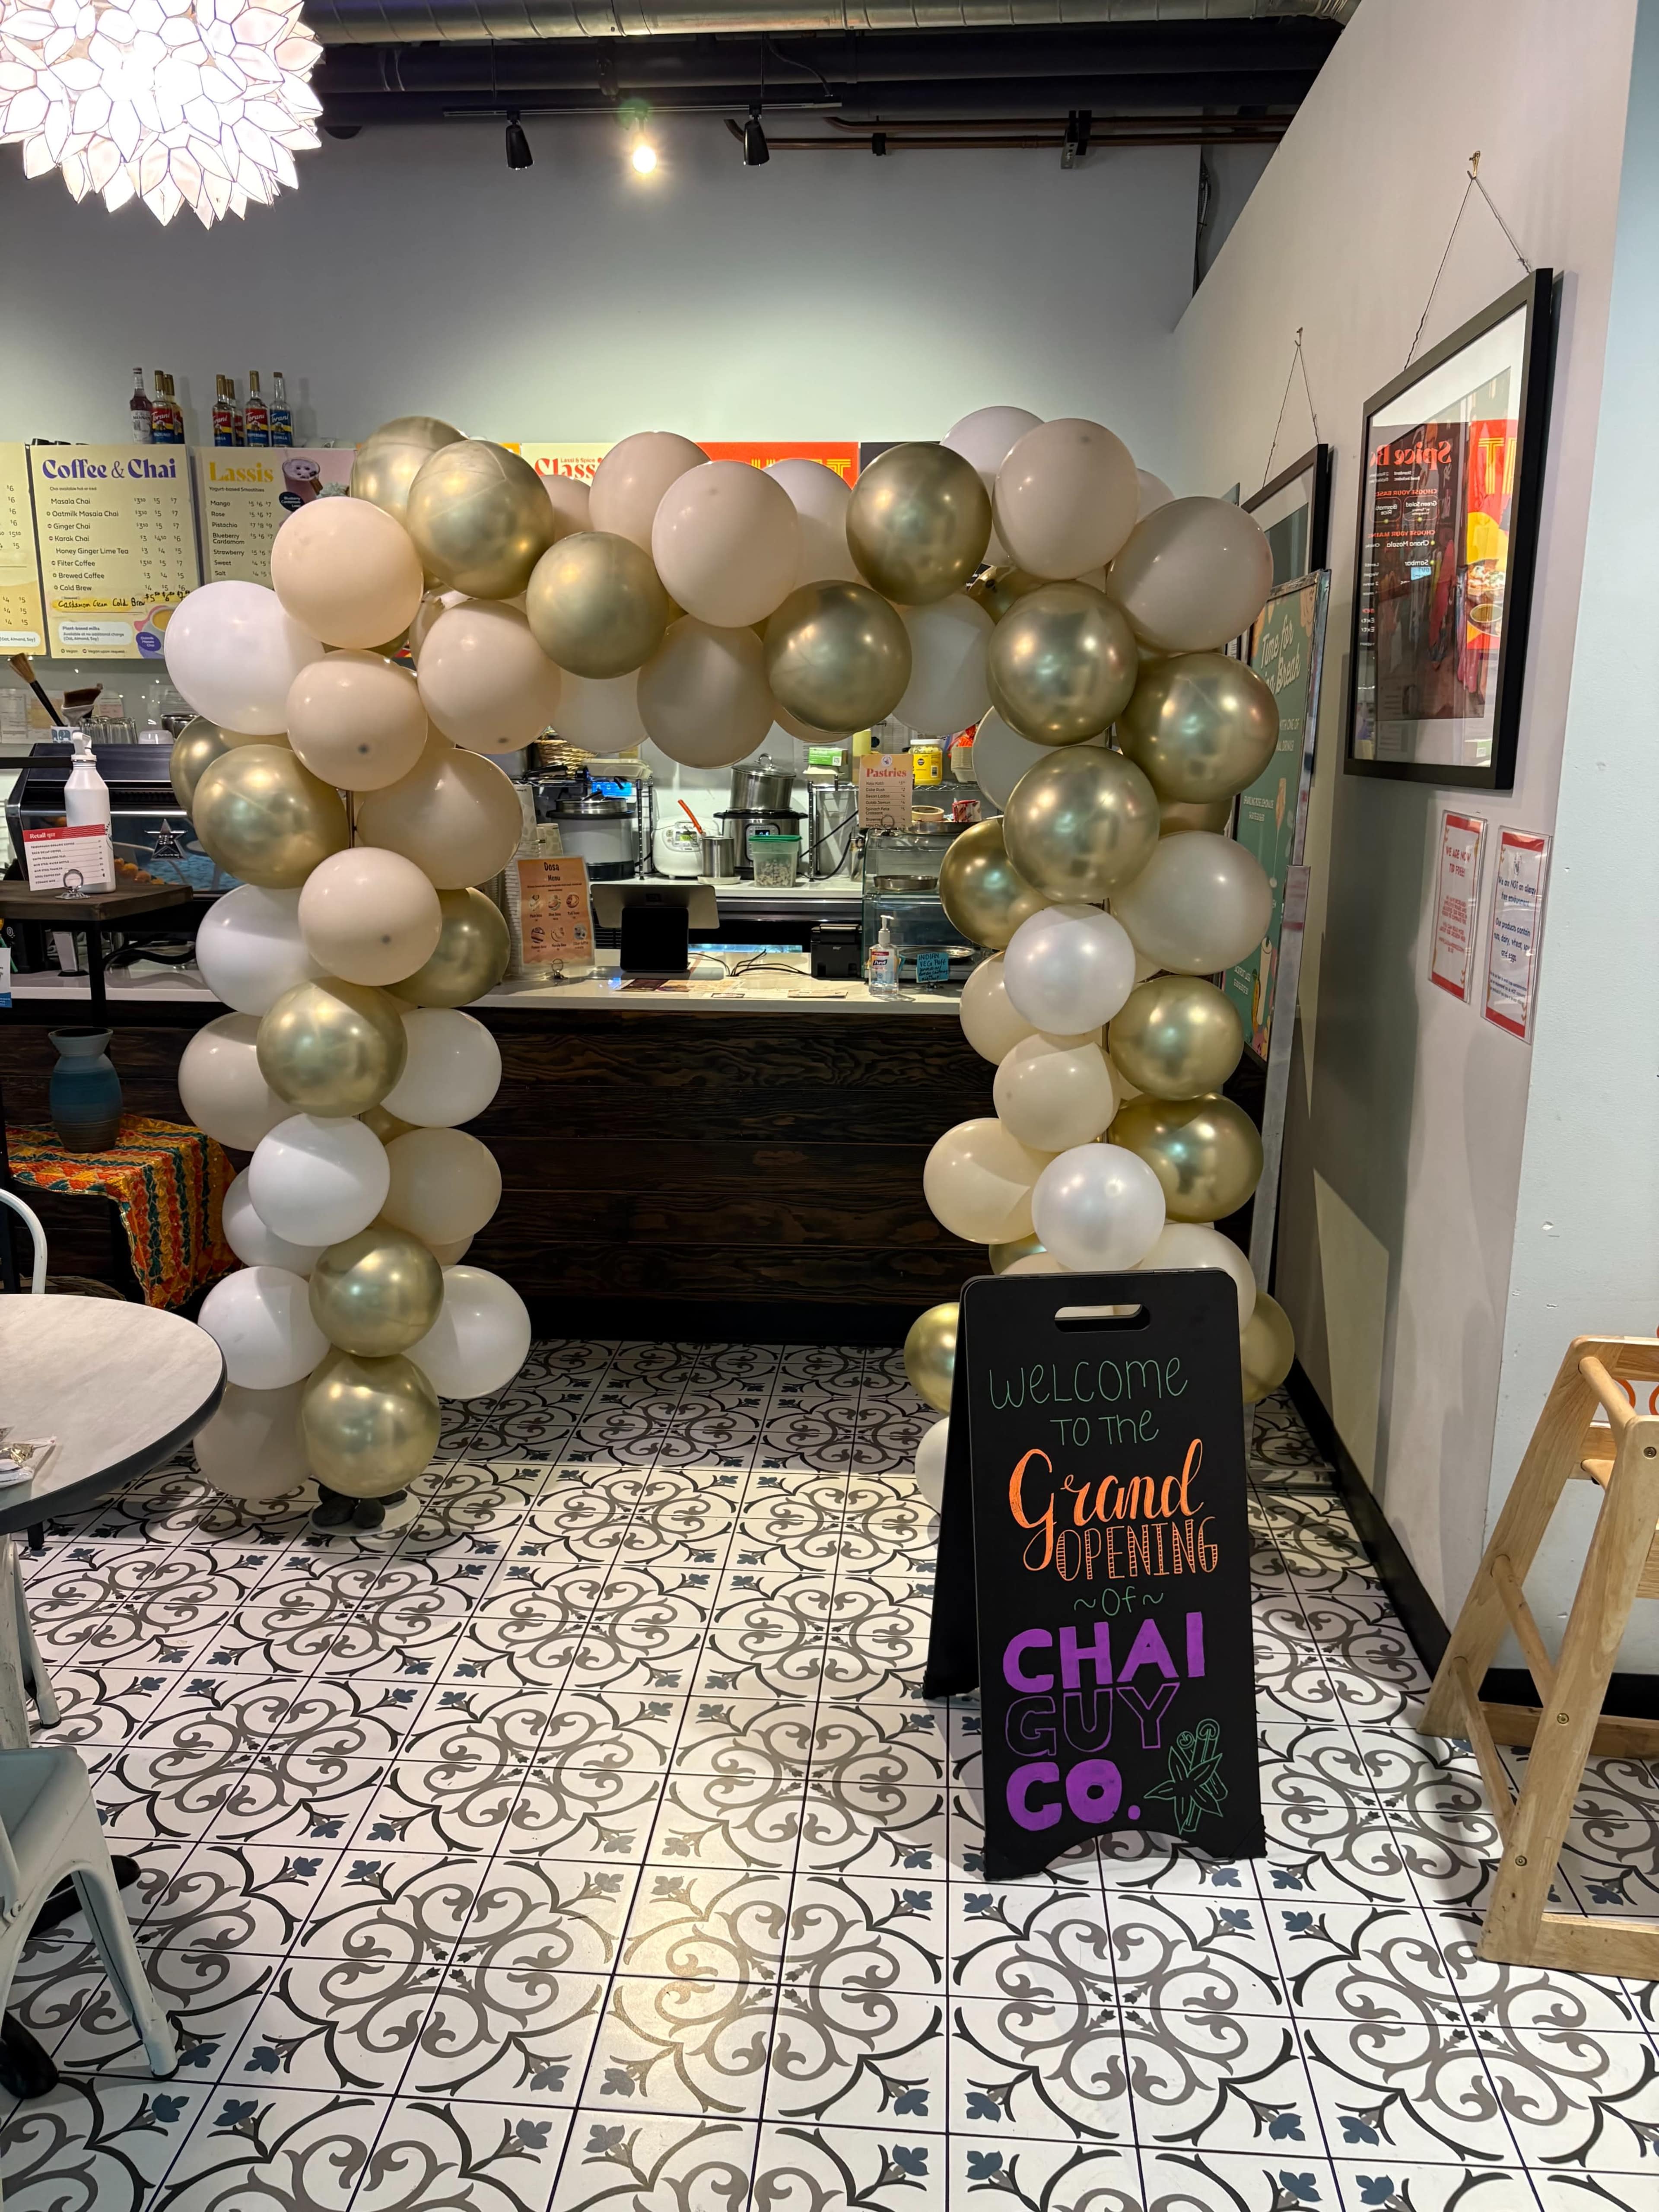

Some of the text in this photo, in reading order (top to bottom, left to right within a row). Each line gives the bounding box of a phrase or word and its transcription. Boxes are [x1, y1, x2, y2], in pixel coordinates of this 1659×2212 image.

[246, 412, 265, 422] Torani
[271, 413, 289, 423] Torani
[43, 458, 176, 478] Coffee & Chai
[210, 461, 274, 482] Lassis
[112, 597, 145, 606] Cold Brew
[1261, 614, 1294, 669] Time for
[1275, 643, 1301, 695] Break
[866, 768, 907, 777] Pastries
[544, 862, 559, 871] Dosa
[1510, 879, 1519, 890] NOT
[1502, 922, 1516, 932] products
[1517, 927, 1530, 937] contain
[1050, 1417, 1090, 1446] TO
[1009, 1438, 1204, 1571] Grand
[1056, 1516, 1218, 1581] OPENING
[1002, 1611, 1205, 1693] CHAI
[1005, 1682, 1180, 1757] GUY
[1006, 1758, 1141, 1831] CO.
